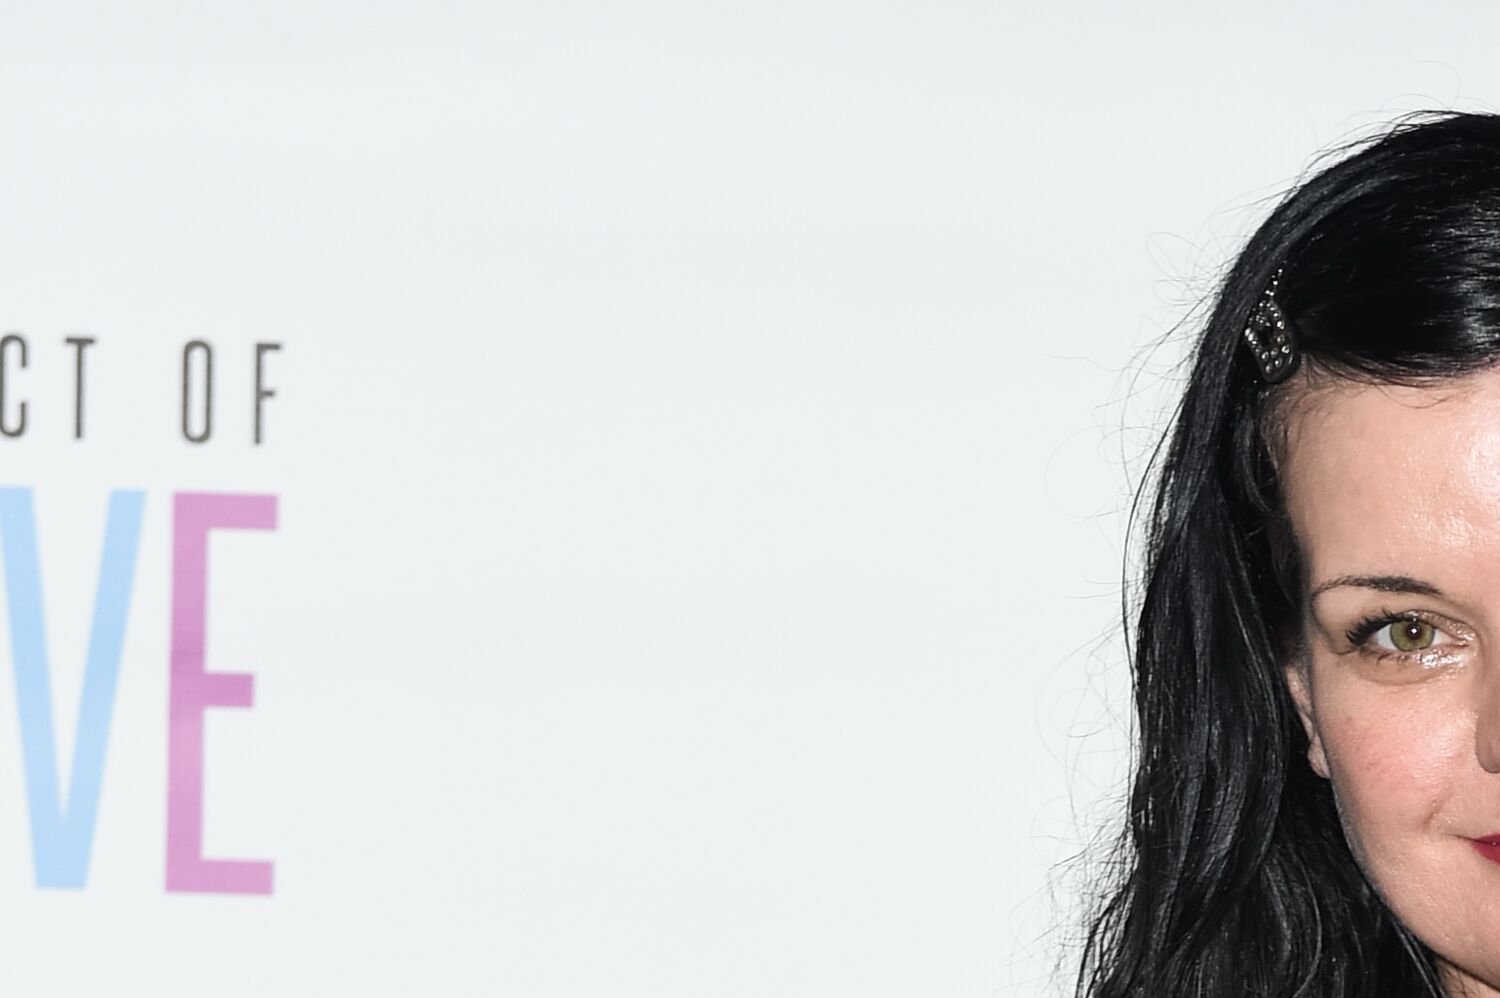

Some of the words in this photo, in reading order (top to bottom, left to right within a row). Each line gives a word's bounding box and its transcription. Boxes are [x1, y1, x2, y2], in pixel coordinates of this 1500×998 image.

[0, 334, 97, 439] CT
[181, 339, 283, 445] OF
[0, 485, 280, 896] VE
